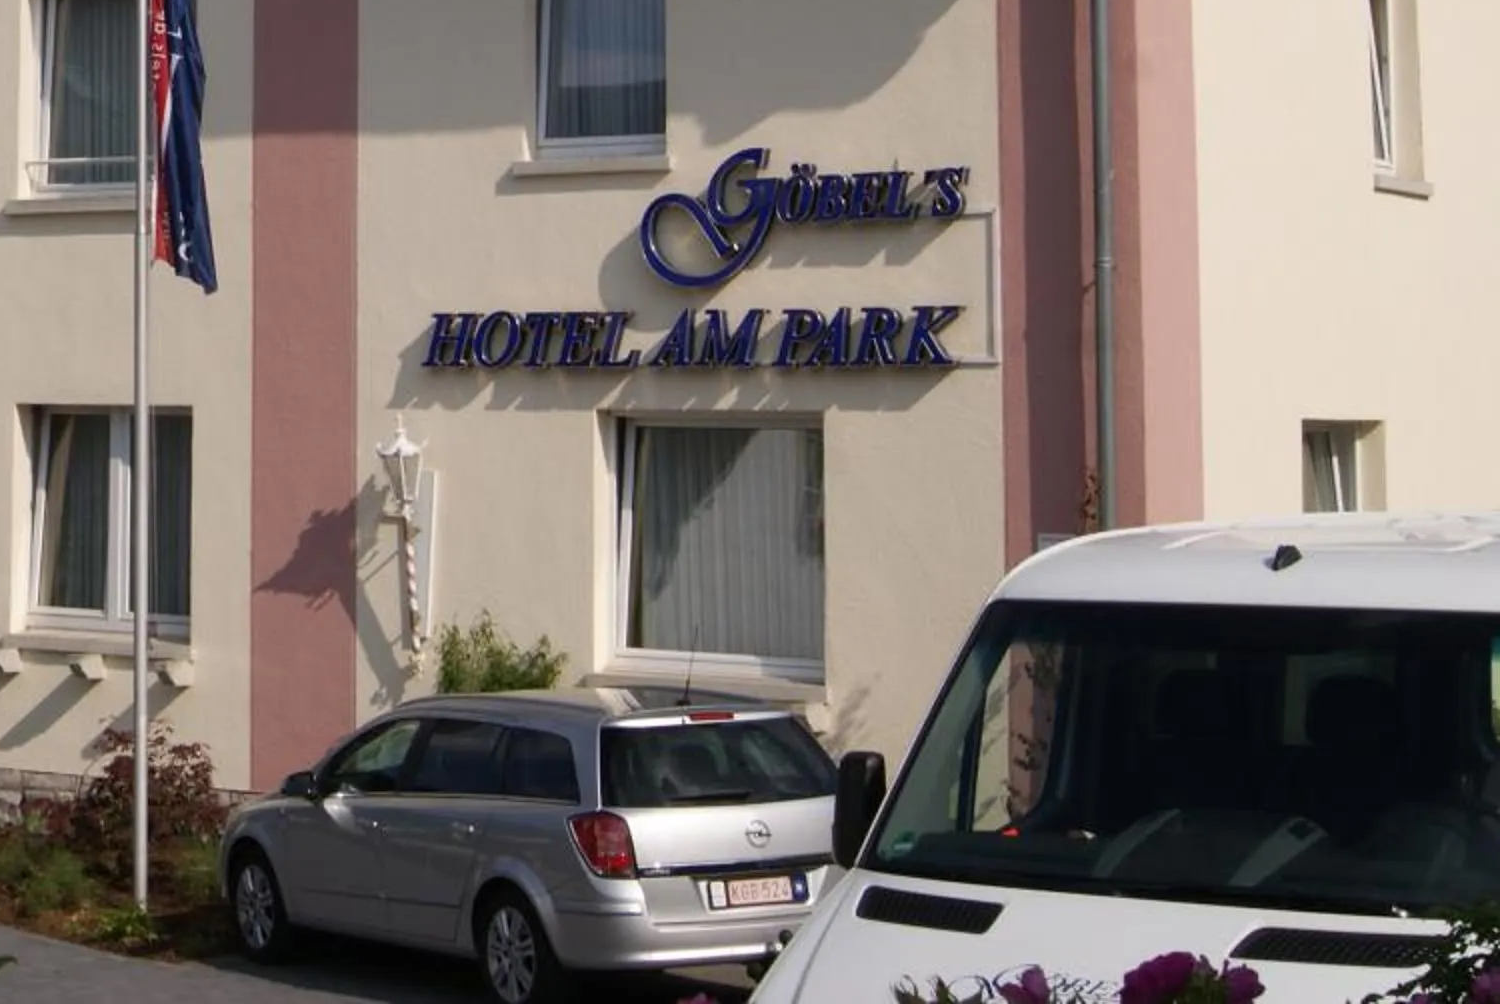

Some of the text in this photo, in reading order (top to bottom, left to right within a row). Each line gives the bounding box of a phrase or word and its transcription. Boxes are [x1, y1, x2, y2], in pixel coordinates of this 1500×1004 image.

[422, 306, 965, 369] HOTEL AM PARK
